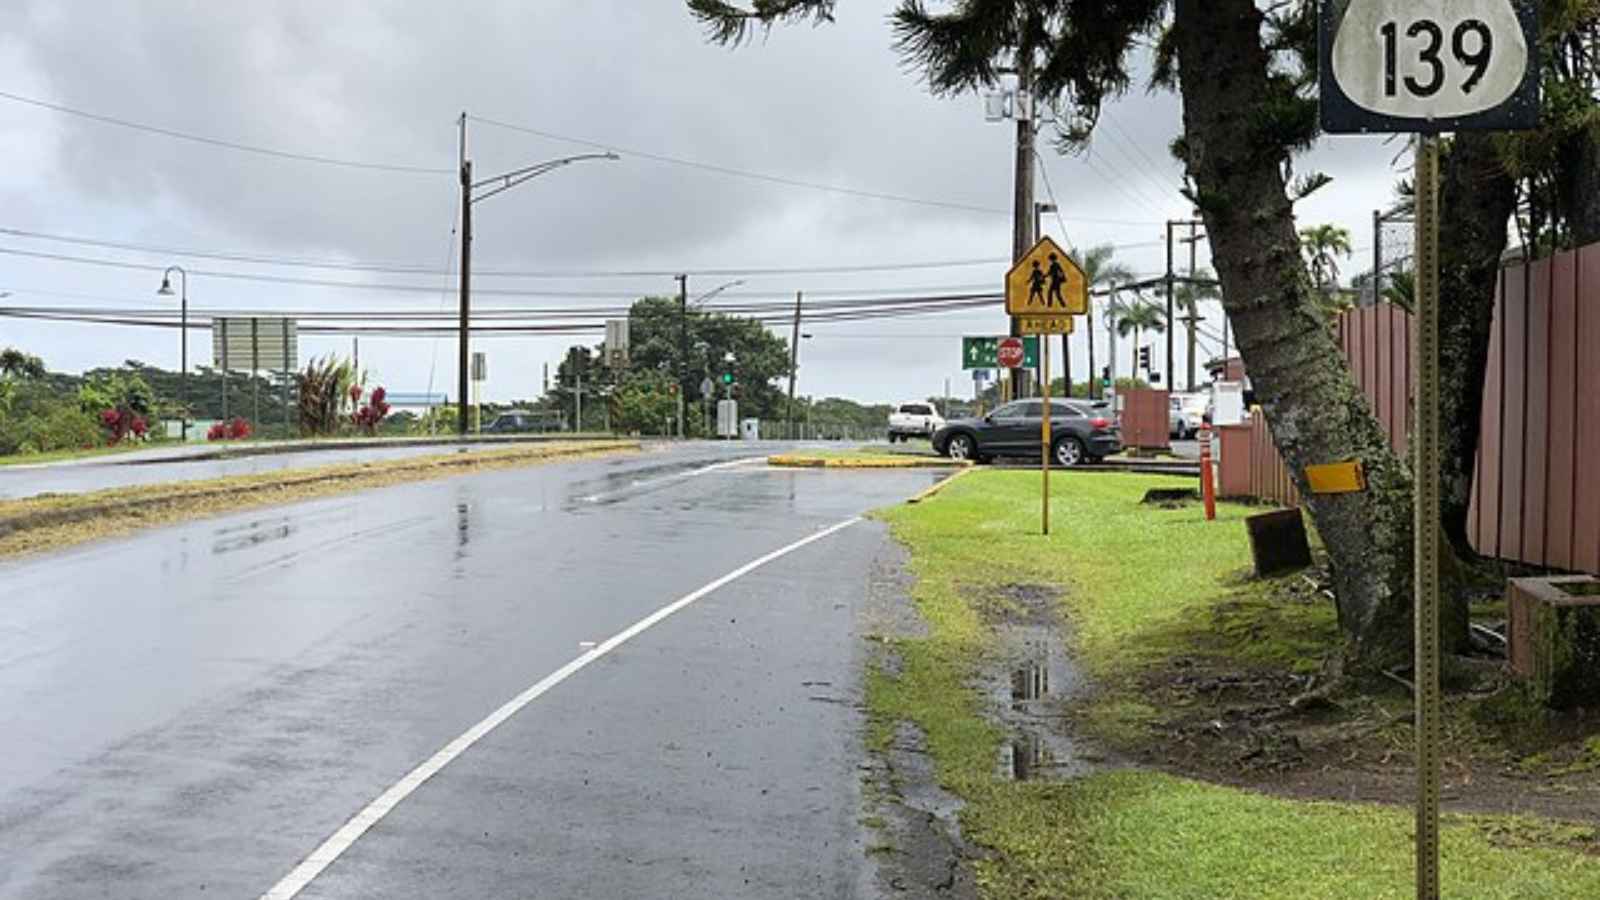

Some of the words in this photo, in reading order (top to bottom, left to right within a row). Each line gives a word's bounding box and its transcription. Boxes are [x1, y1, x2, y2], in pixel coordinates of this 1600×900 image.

[1380, 19, 1493, 97] 139
[1026, 319, 1068, 331] AHEAD
[999, 347, 1022, 358] STOP
